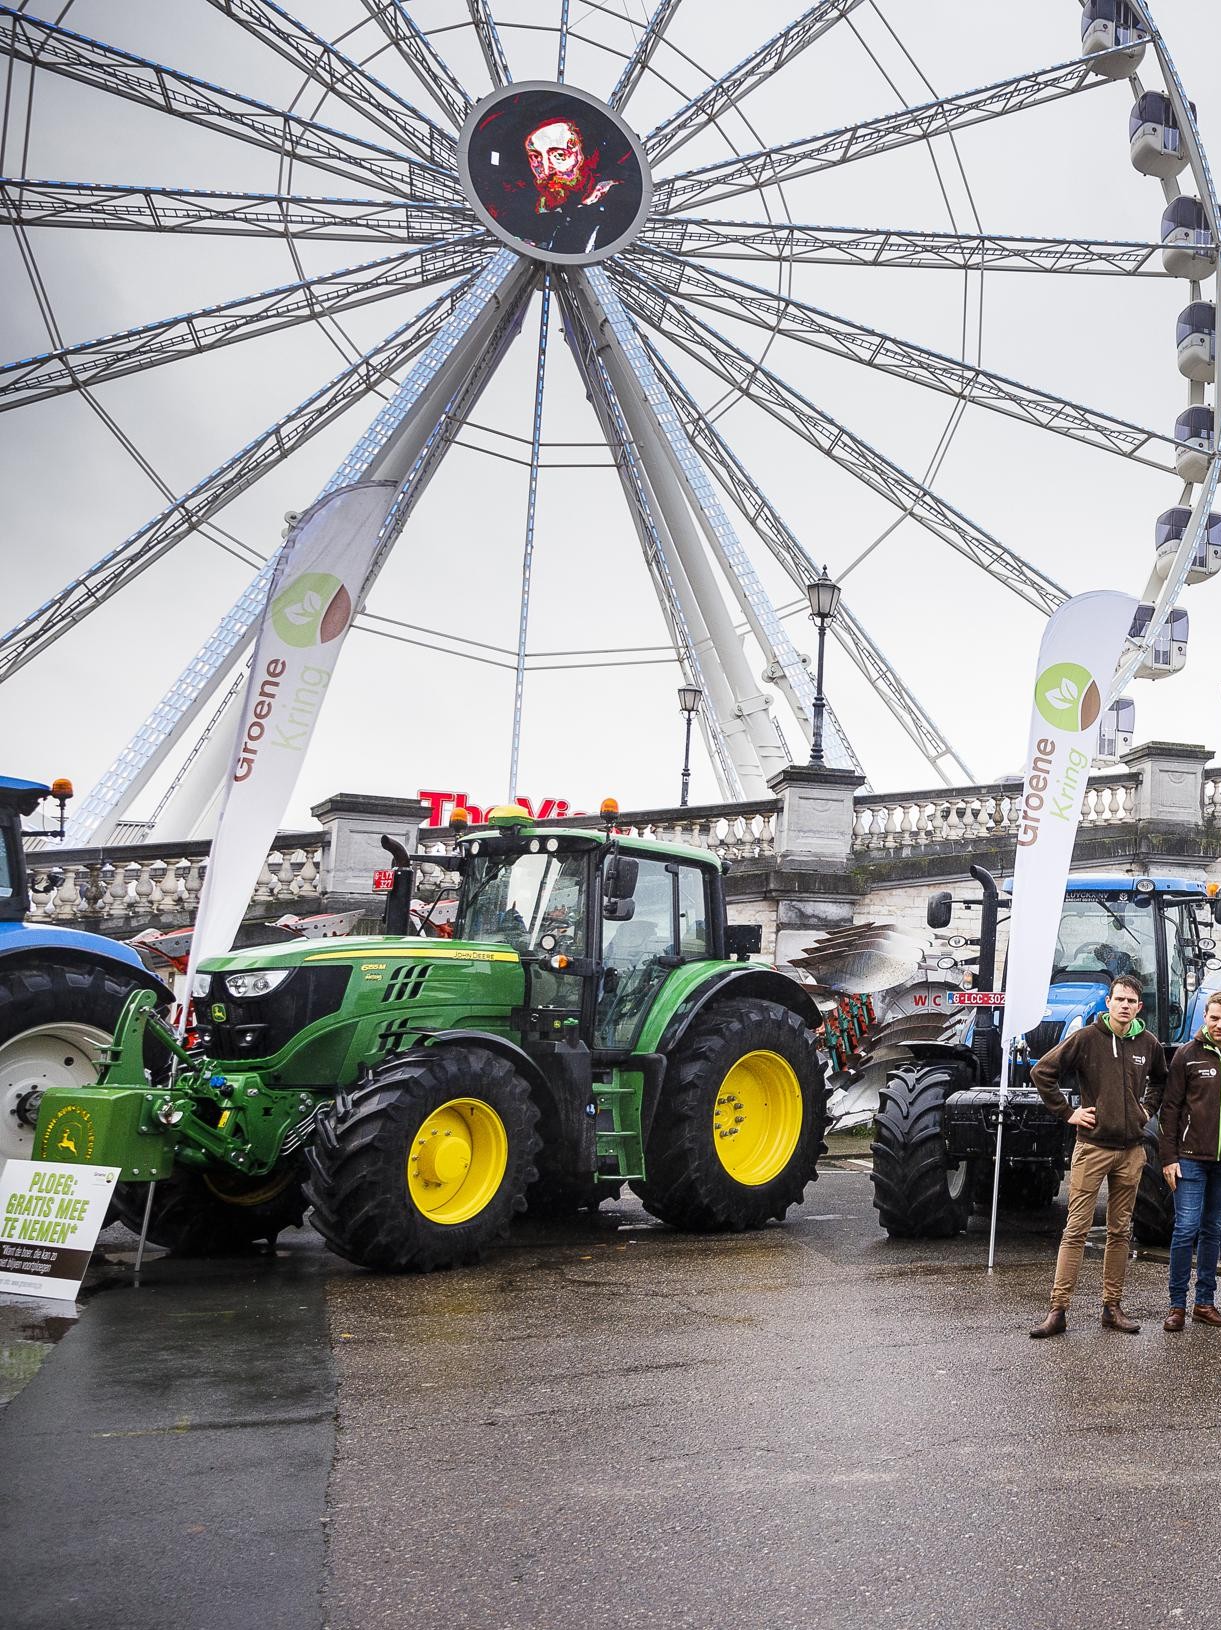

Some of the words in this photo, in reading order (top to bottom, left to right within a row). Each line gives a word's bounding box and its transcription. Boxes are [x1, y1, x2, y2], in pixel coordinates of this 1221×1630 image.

[233, 658, 287, 783] Groene
[271, 664, 332, 752] Kring
[1017, 738, 1056, 847] Groene
[1049, 747, 1089, 822] Kring
[454, 951, 472, 960] JOHN
[472, 952, 496, 961] DEERE
[6, 1193, 54, 1218] GRATIS
[55, 1198, 90, 1221] MEE
[28, 1171, 79, 1196] PLOEG:
[0, 1216, 19, 1239] TE
